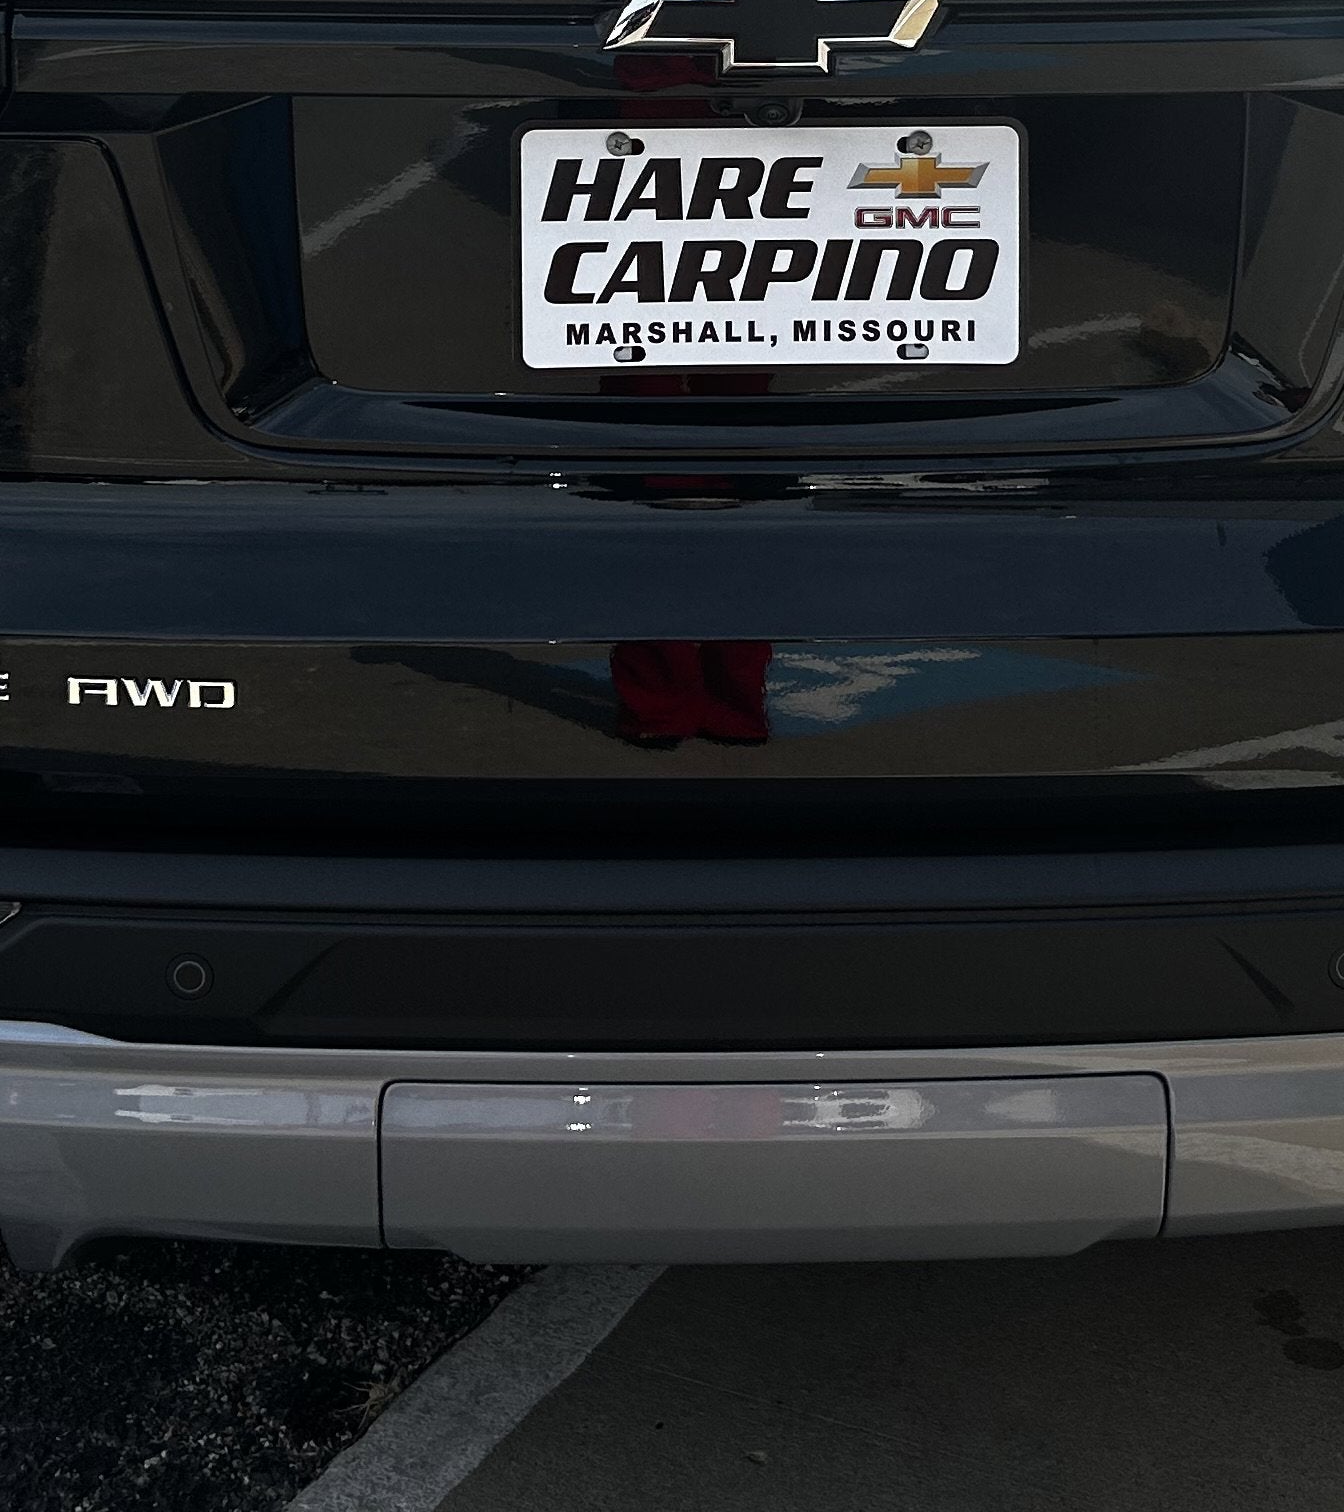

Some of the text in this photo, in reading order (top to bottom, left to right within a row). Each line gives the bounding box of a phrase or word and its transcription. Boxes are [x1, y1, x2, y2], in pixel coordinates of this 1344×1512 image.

[541, 156, 824, 223] HARE
[854, 205, 982, 230] GMC
[543, 238, 1000, 305] CARPINO
[566, 319, 977, 348] MARSHALL, MISSOURI
[67, 676, 236, 709] AWD
